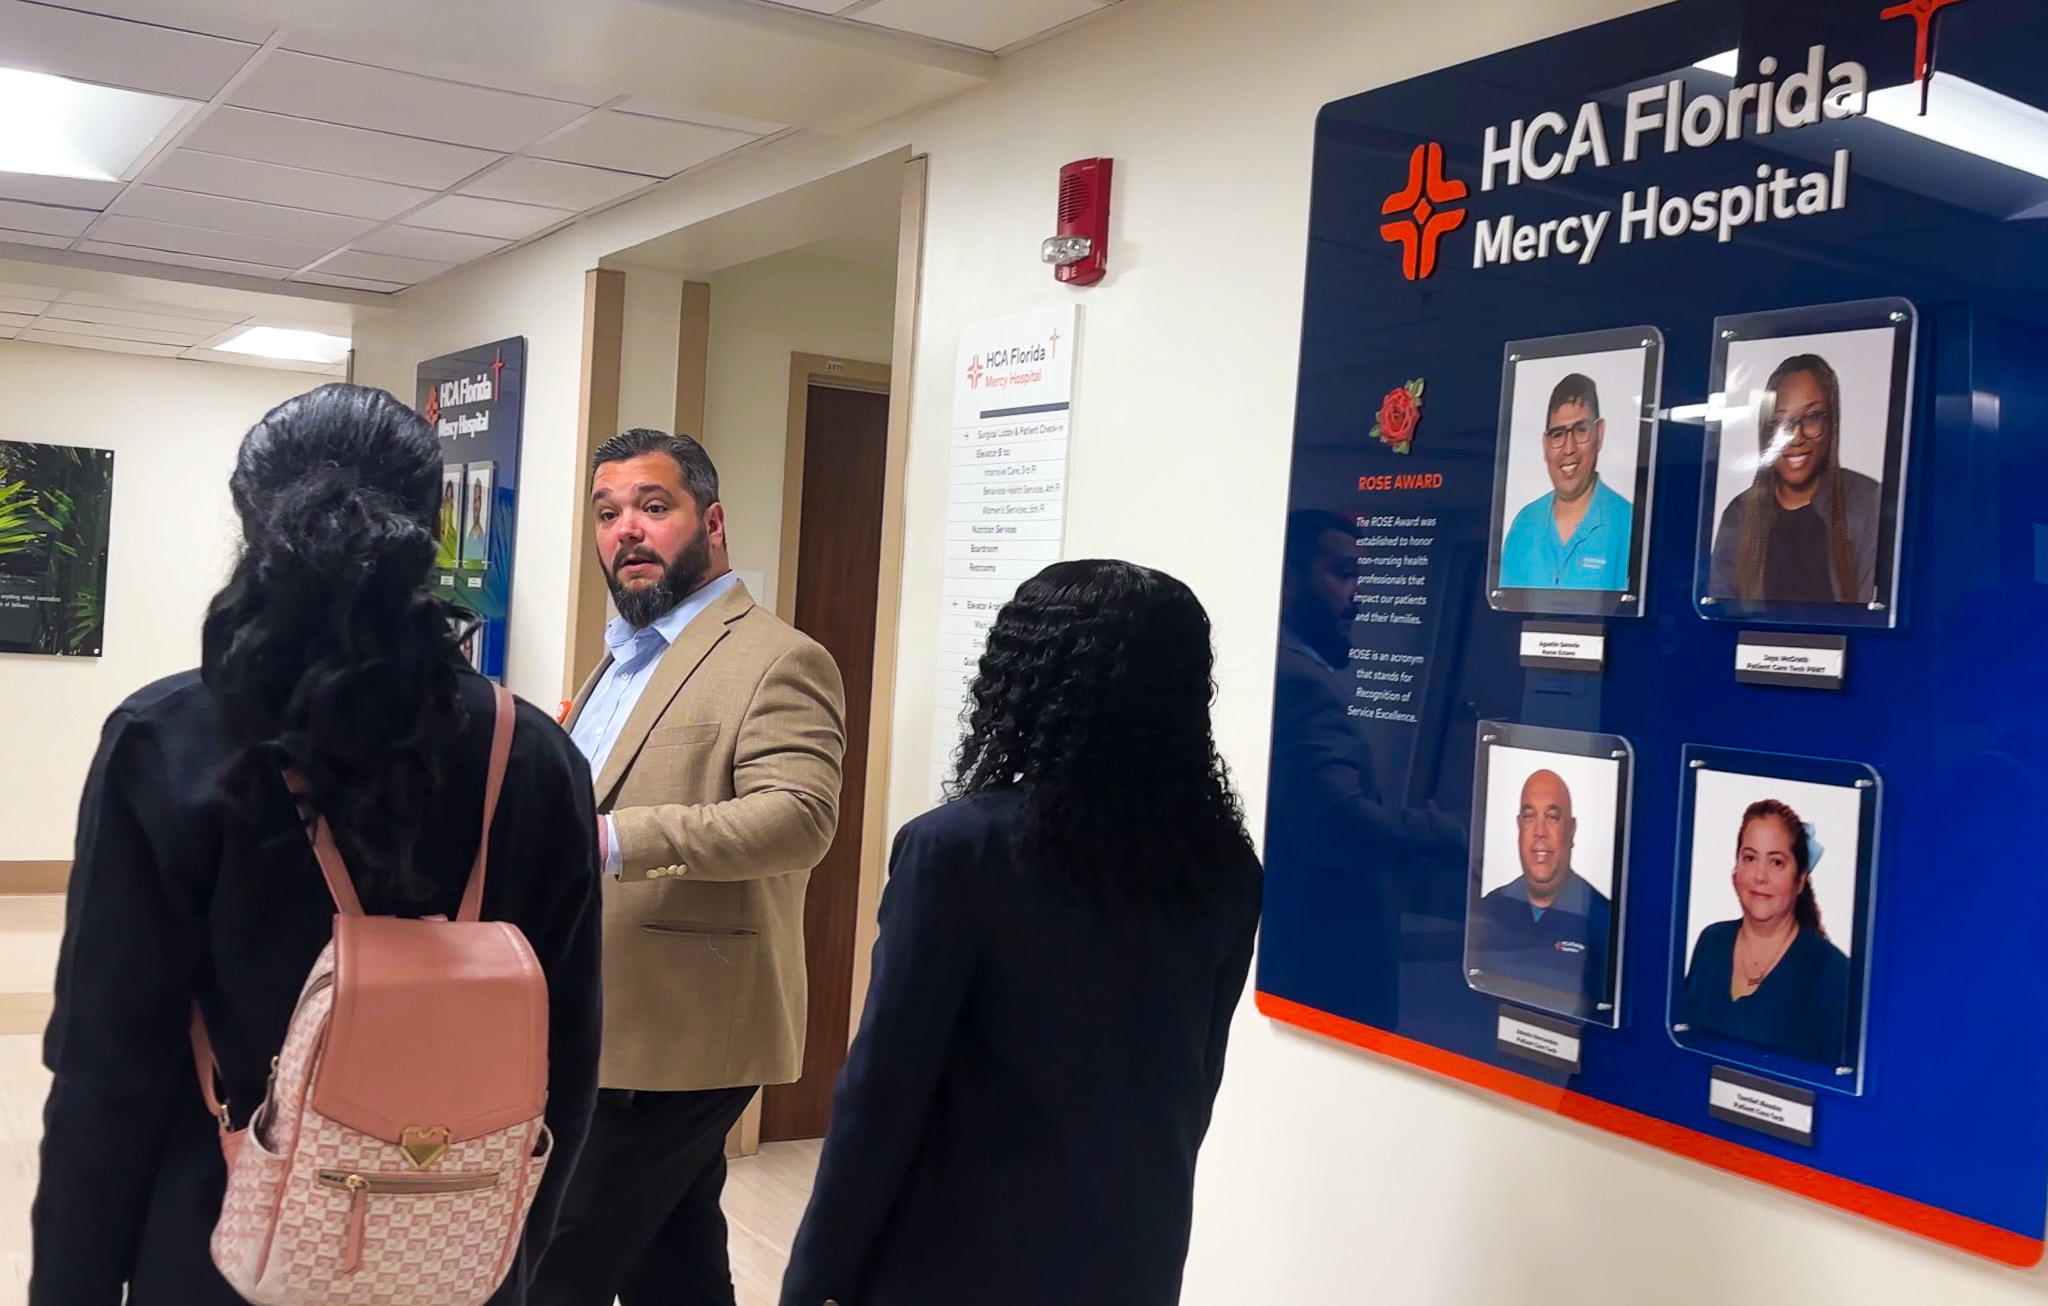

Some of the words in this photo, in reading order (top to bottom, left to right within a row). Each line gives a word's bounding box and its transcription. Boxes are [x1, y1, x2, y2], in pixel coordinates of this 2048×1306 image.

[1480, 101, 1611, 193] HCA
[1621, 43, 1869, 163] Florida
[1472, 208, 1611, 271] Mercy
[1618, 148, 1852, 244] Hospital
[986, 348, 1008, 369] HCA
[1010, 343, 1046, 365] Florida
[984, 374, 1008, 390] Mercy
[1008, 368, 1042, 386] Hospital
[440, 380, 459, 408] HCA
[460, 372, 492, 404] Florida
[438, 418, 459, 440] Mercy
[458, 410, 490, 438] Hospital
[1358, 475, 1392, 491] ROSE
[1393, 472, 1444, 490] AWARD
[1356, 516, 1370, 527] The
[1370, 516, 1394, 527] ROSE
[1394, 516, 1420, 527] Award
[1420, 518, 1437, 527] was
[1356, 536, 1398, 546] established
[1399, 536, 1408, 546] to
[1409, 536, 1434, 546] honor
[1356, 554, 1402, 568] non-nursing
[1403, 555, 1428, 566] health
[1356, 574, 1406, 586] professionals
[1408, 575, 1426, 586] that
[1352, 592, 1379, 604] impact
[1380, 595, 1394, 604] our
[1394, 594, 1427, 606] patients
[1355, 612, 1370, 622] and
[1370, 612, 1389, 623] their
[1348, 648, 1371, 660] ROSE
[1379, 652, 1390, 661] an
[1390, 654, 1424, 666] acronym
[1357, 668, 1373, 679] that
[1373, 670, 1400, 682] stands
[1400, 672, 1414, 682] for
[1772, 664, 1788, 672] Care
[1355, 686, 1400, 701] Recognition
[1401, 692, 1412, 702] of
[1347, 705, 1374, 718] Service
